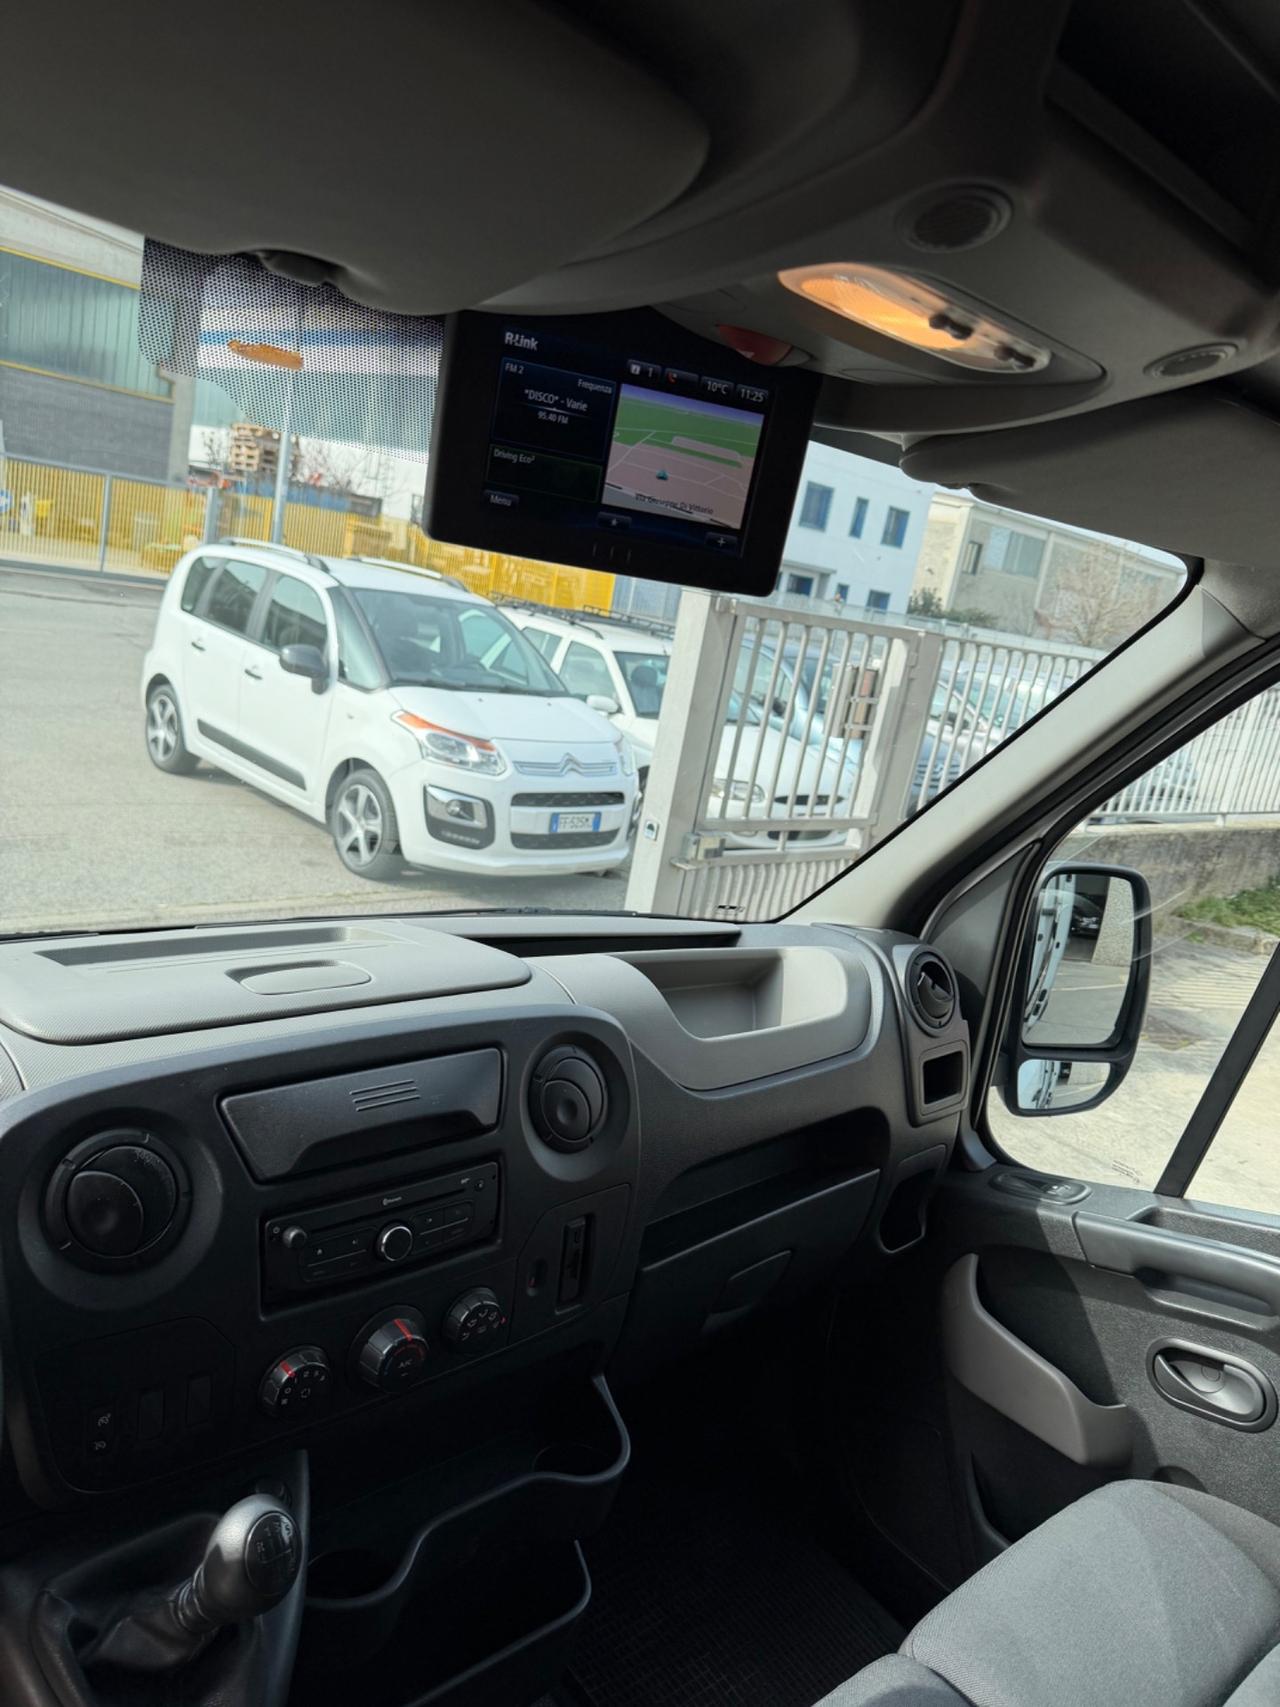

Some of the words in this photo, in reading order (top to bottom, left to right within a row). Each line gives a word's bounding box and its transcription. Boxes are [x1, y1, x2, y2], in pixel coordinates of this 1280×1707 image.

[505, 362, 518, 373] FM
[519, 365, 525, 375] 2
[578, 378, 613, 394] Frequenza
[740, 388, 764, 403] 11:25
[566, 397, 589, 412] Varie
[537, 410, 557, 422] 95.40
[557, 414, 569, 424] FM
[493, 448, 518, 463] Driving
[489, 494, 512, 507] Menu
